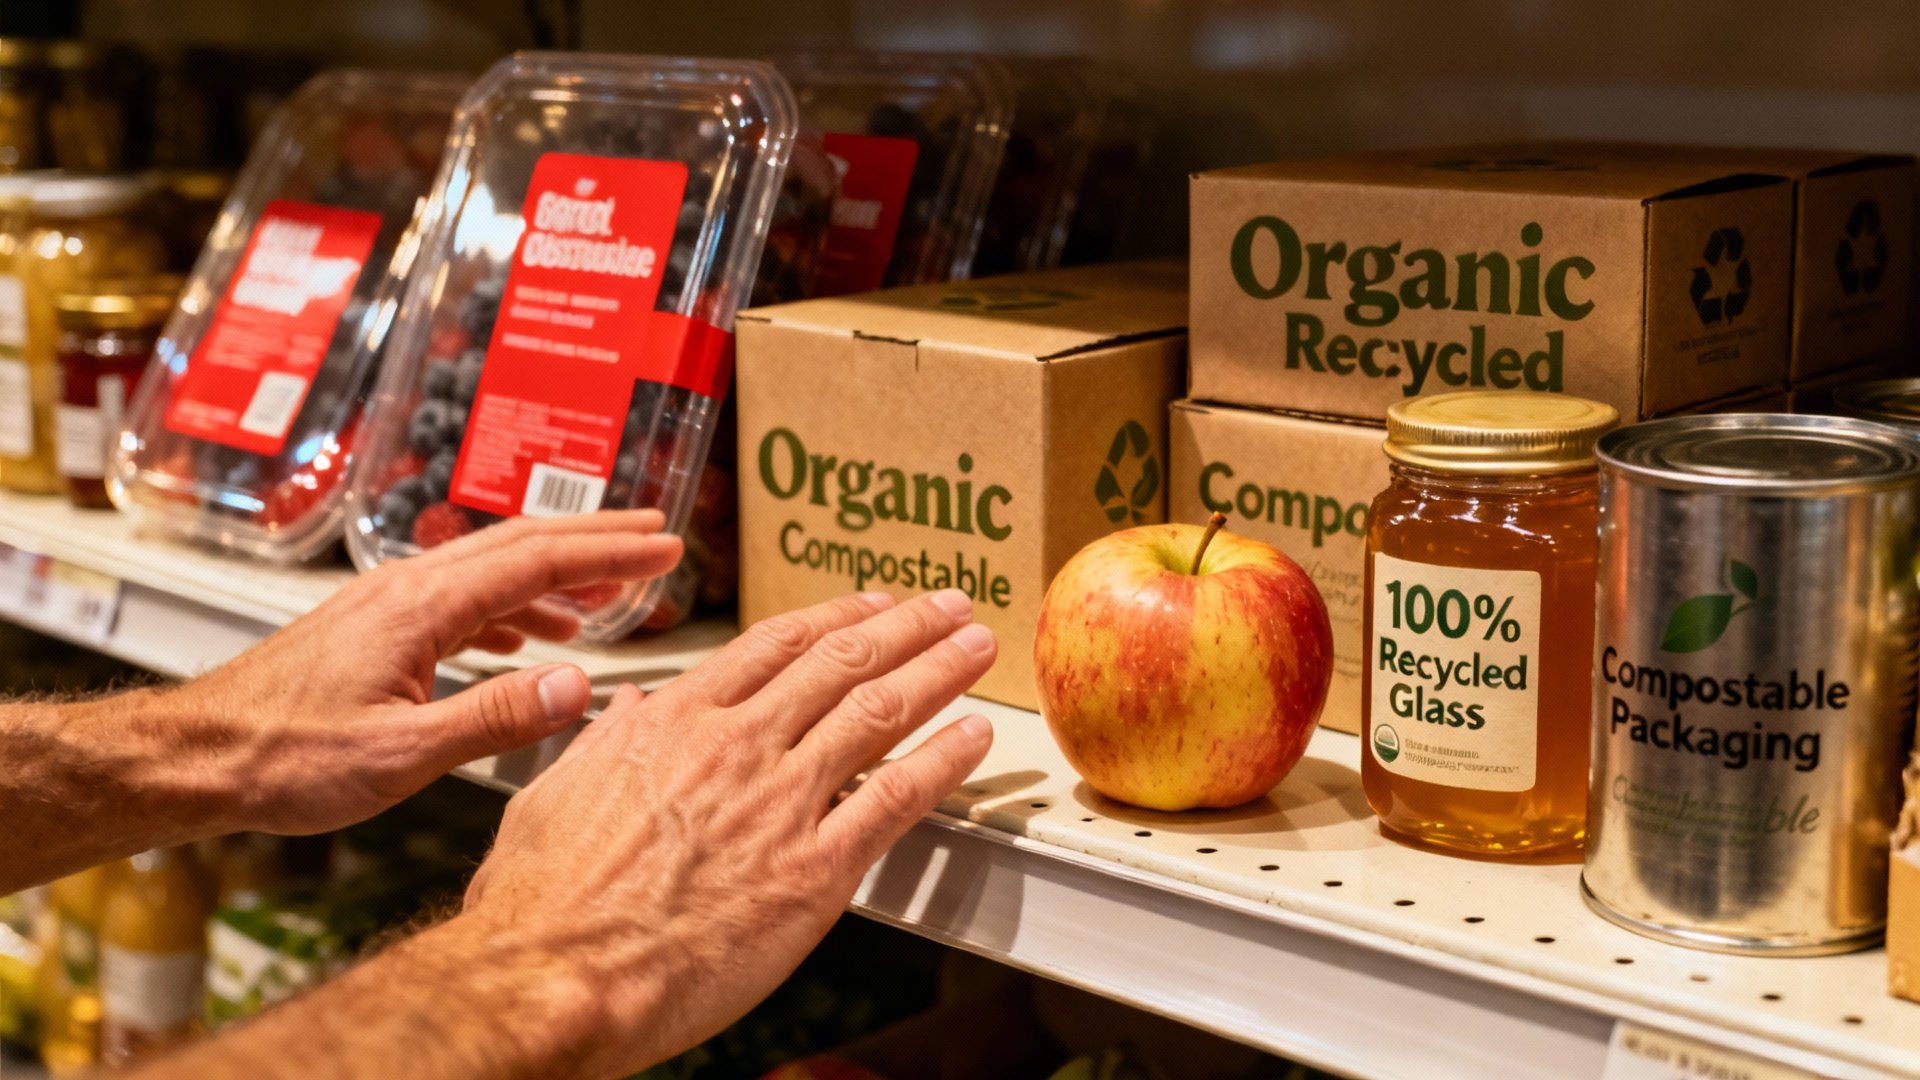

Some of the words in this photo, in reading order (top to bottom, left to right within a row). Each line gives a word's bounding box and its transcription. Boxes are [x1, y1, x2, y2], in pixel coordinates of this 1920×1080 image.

[1230, 215, 1596, 328] Organic
[1284, 312, 1564, 398] Recycled
[758, 427, 1013, 541] Organic
[780, 520, 1012, 608] Compostable
[1386, 579, 1521, 643] 100%
[1379, 636, 1528, 691] Recycled
[1602, 646, 1850, 711] Compostable
[1389, 682, 1486, 730] Glass
[1611, 696, 1822, 773] Packaging
